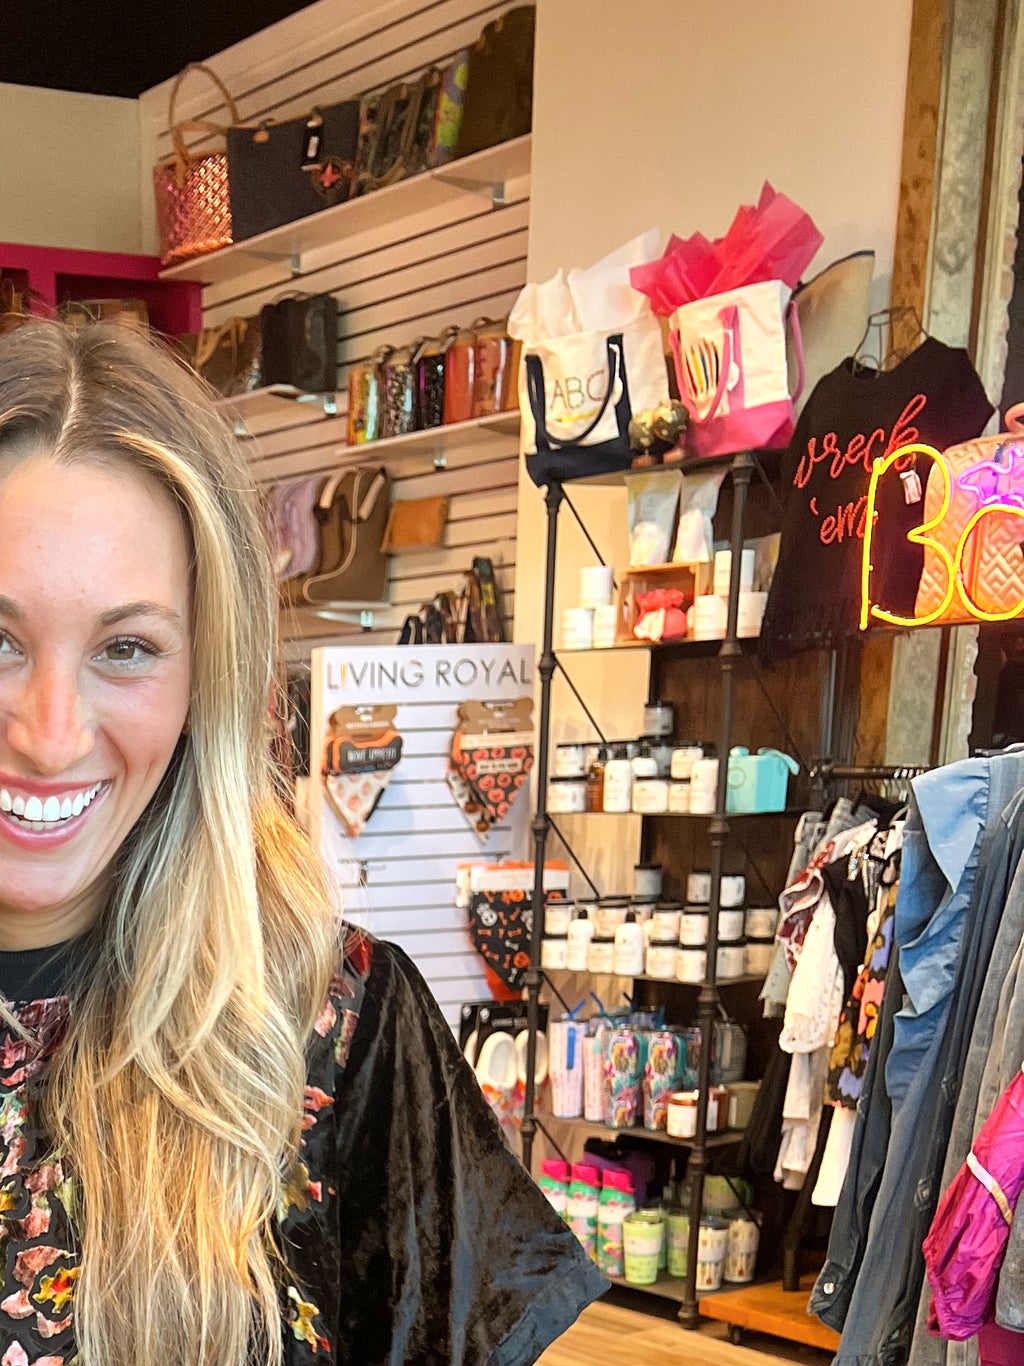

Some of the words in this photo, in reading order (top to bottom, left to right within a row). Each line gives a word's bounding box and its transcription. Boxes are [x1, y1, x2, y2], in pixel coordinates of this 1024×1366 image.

[550, 369, 606, 410] ABC
[327, 659, 424, 690] LIVING
[435, 657, 533, 687] ROYAL
